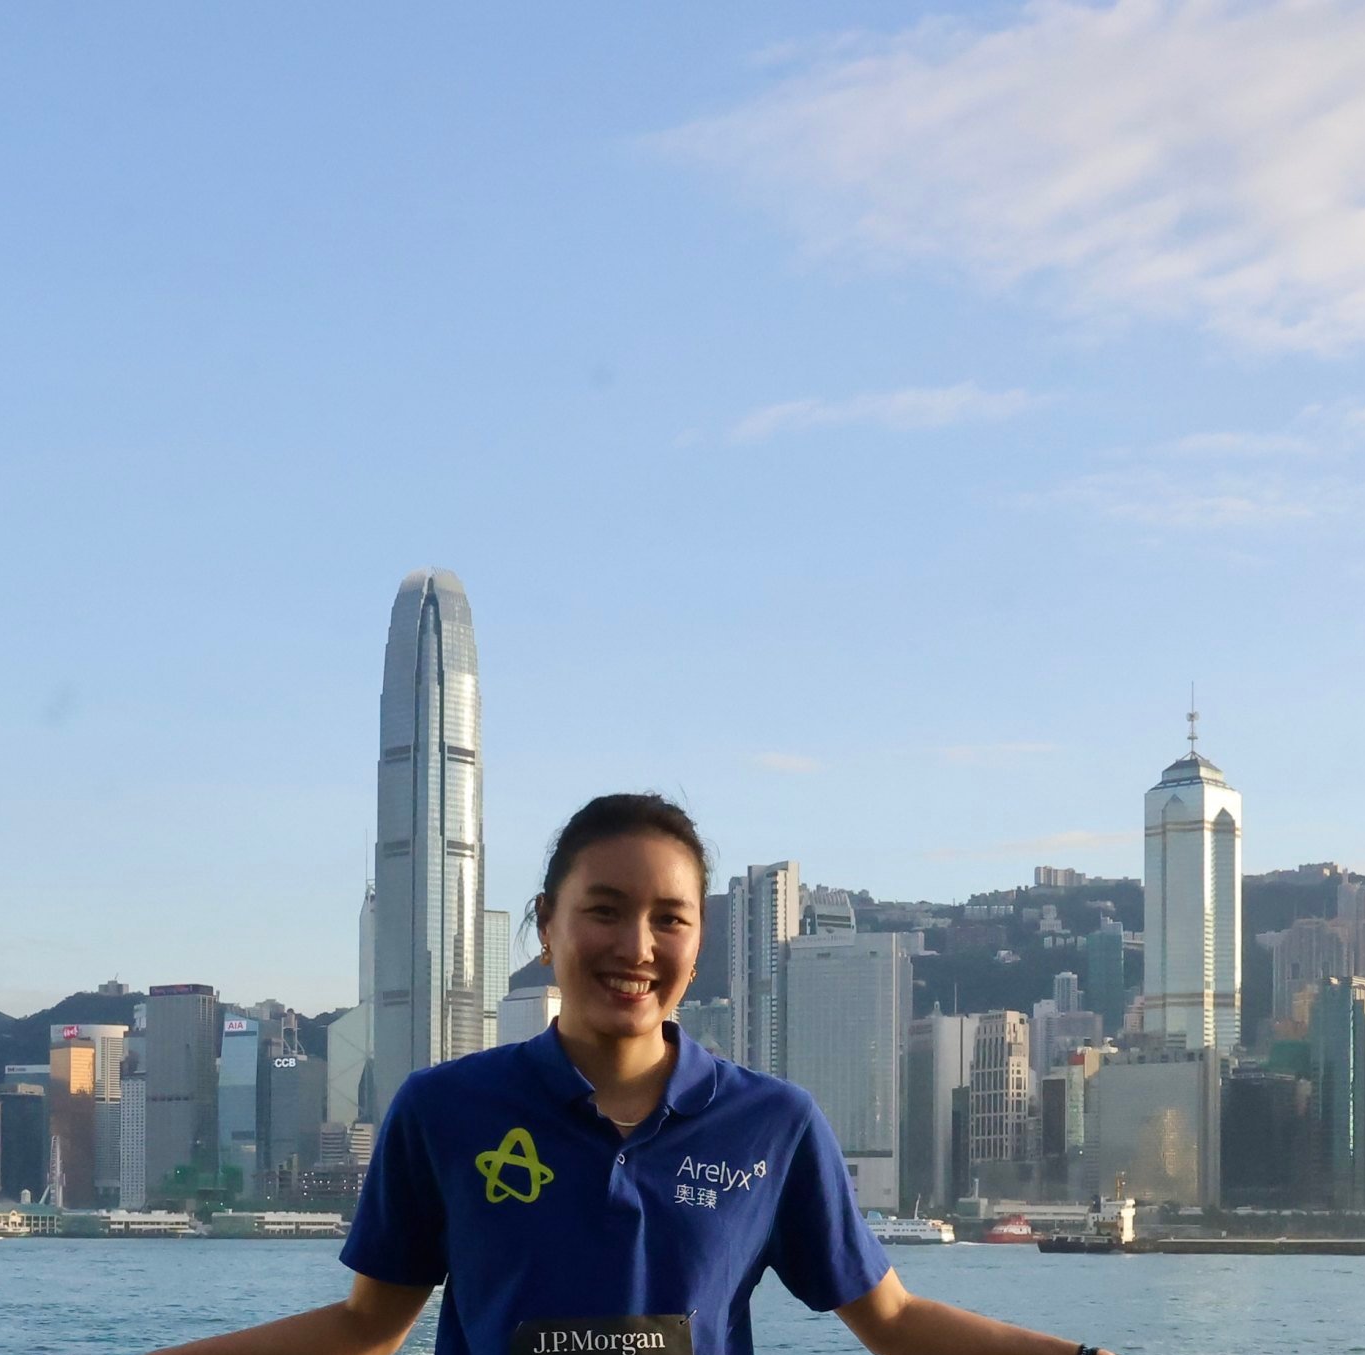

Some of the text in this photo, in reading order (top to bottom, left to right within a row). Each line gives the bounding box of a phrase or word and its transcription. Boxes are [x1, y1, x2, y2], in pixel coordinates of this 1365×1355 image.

[227, 1022, 244, 1030] AIA
[274, 1058, 296, 1068] CCB
[676, 1155, 752, 1192] Arelyx
